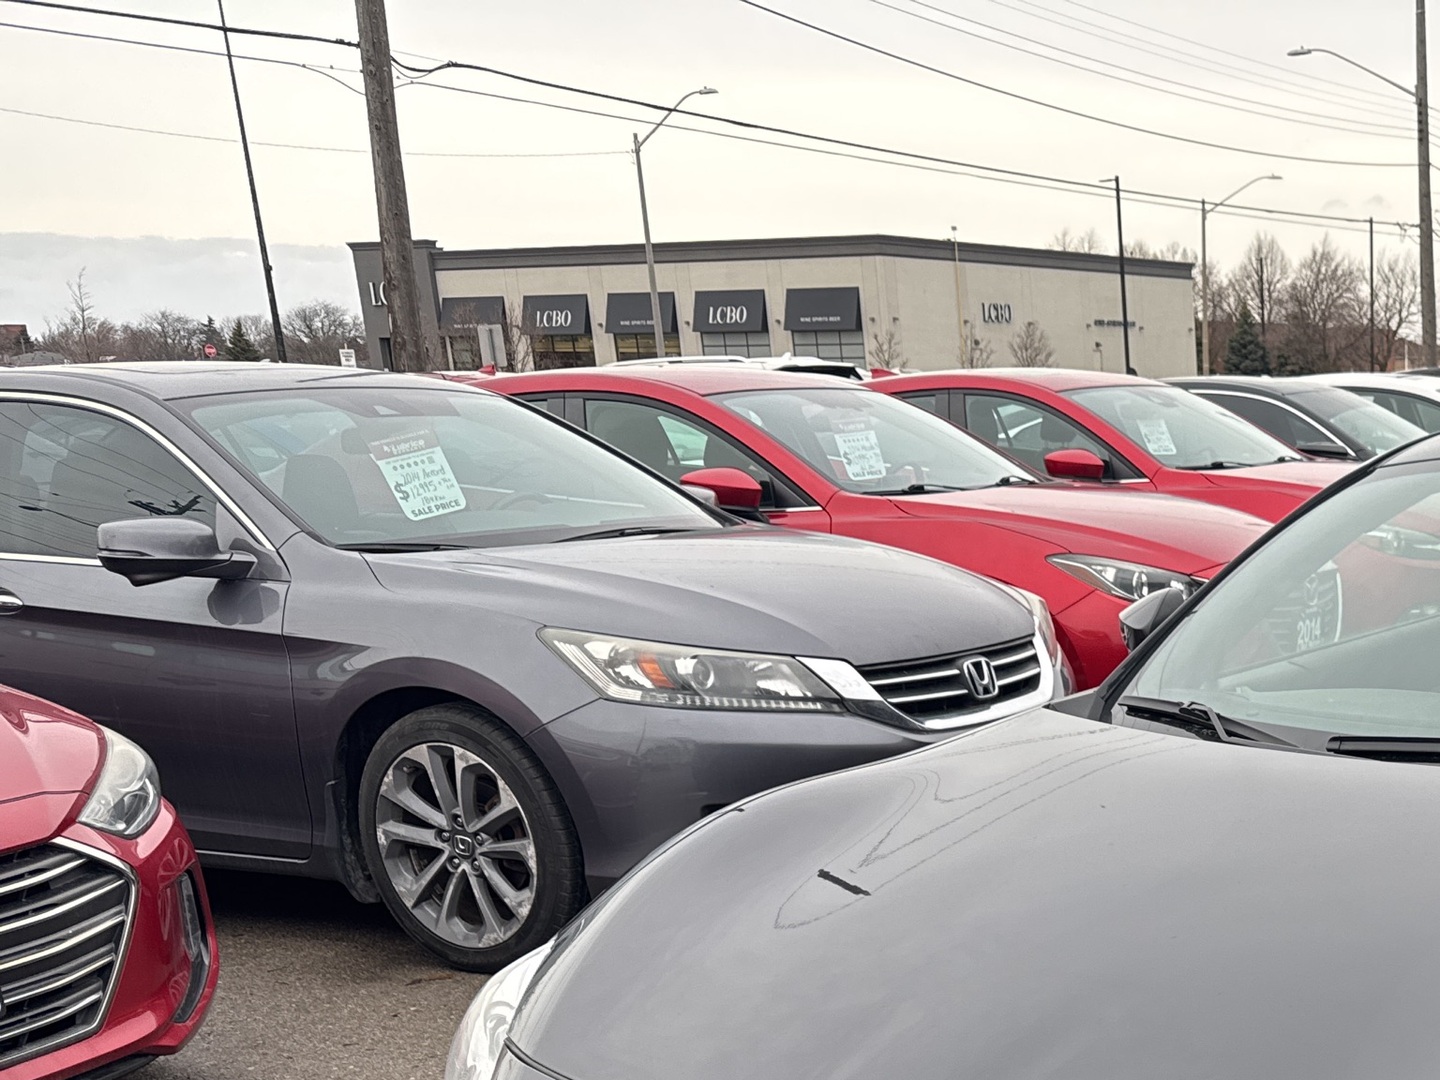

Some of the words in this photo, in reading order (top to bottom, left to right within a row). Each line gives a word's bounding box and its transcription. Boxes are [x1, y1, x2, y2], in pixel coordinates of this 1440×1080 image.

[536, 310, 571, 327] LCBO
[709, 306, 747, 324] LCBO
[982, 303, 1012, 323] LCBO
[411, 506, 434, 517] SALE
[434, 499, 461, 512] PRICE
[1297, 617, 1320, 644] 2014
